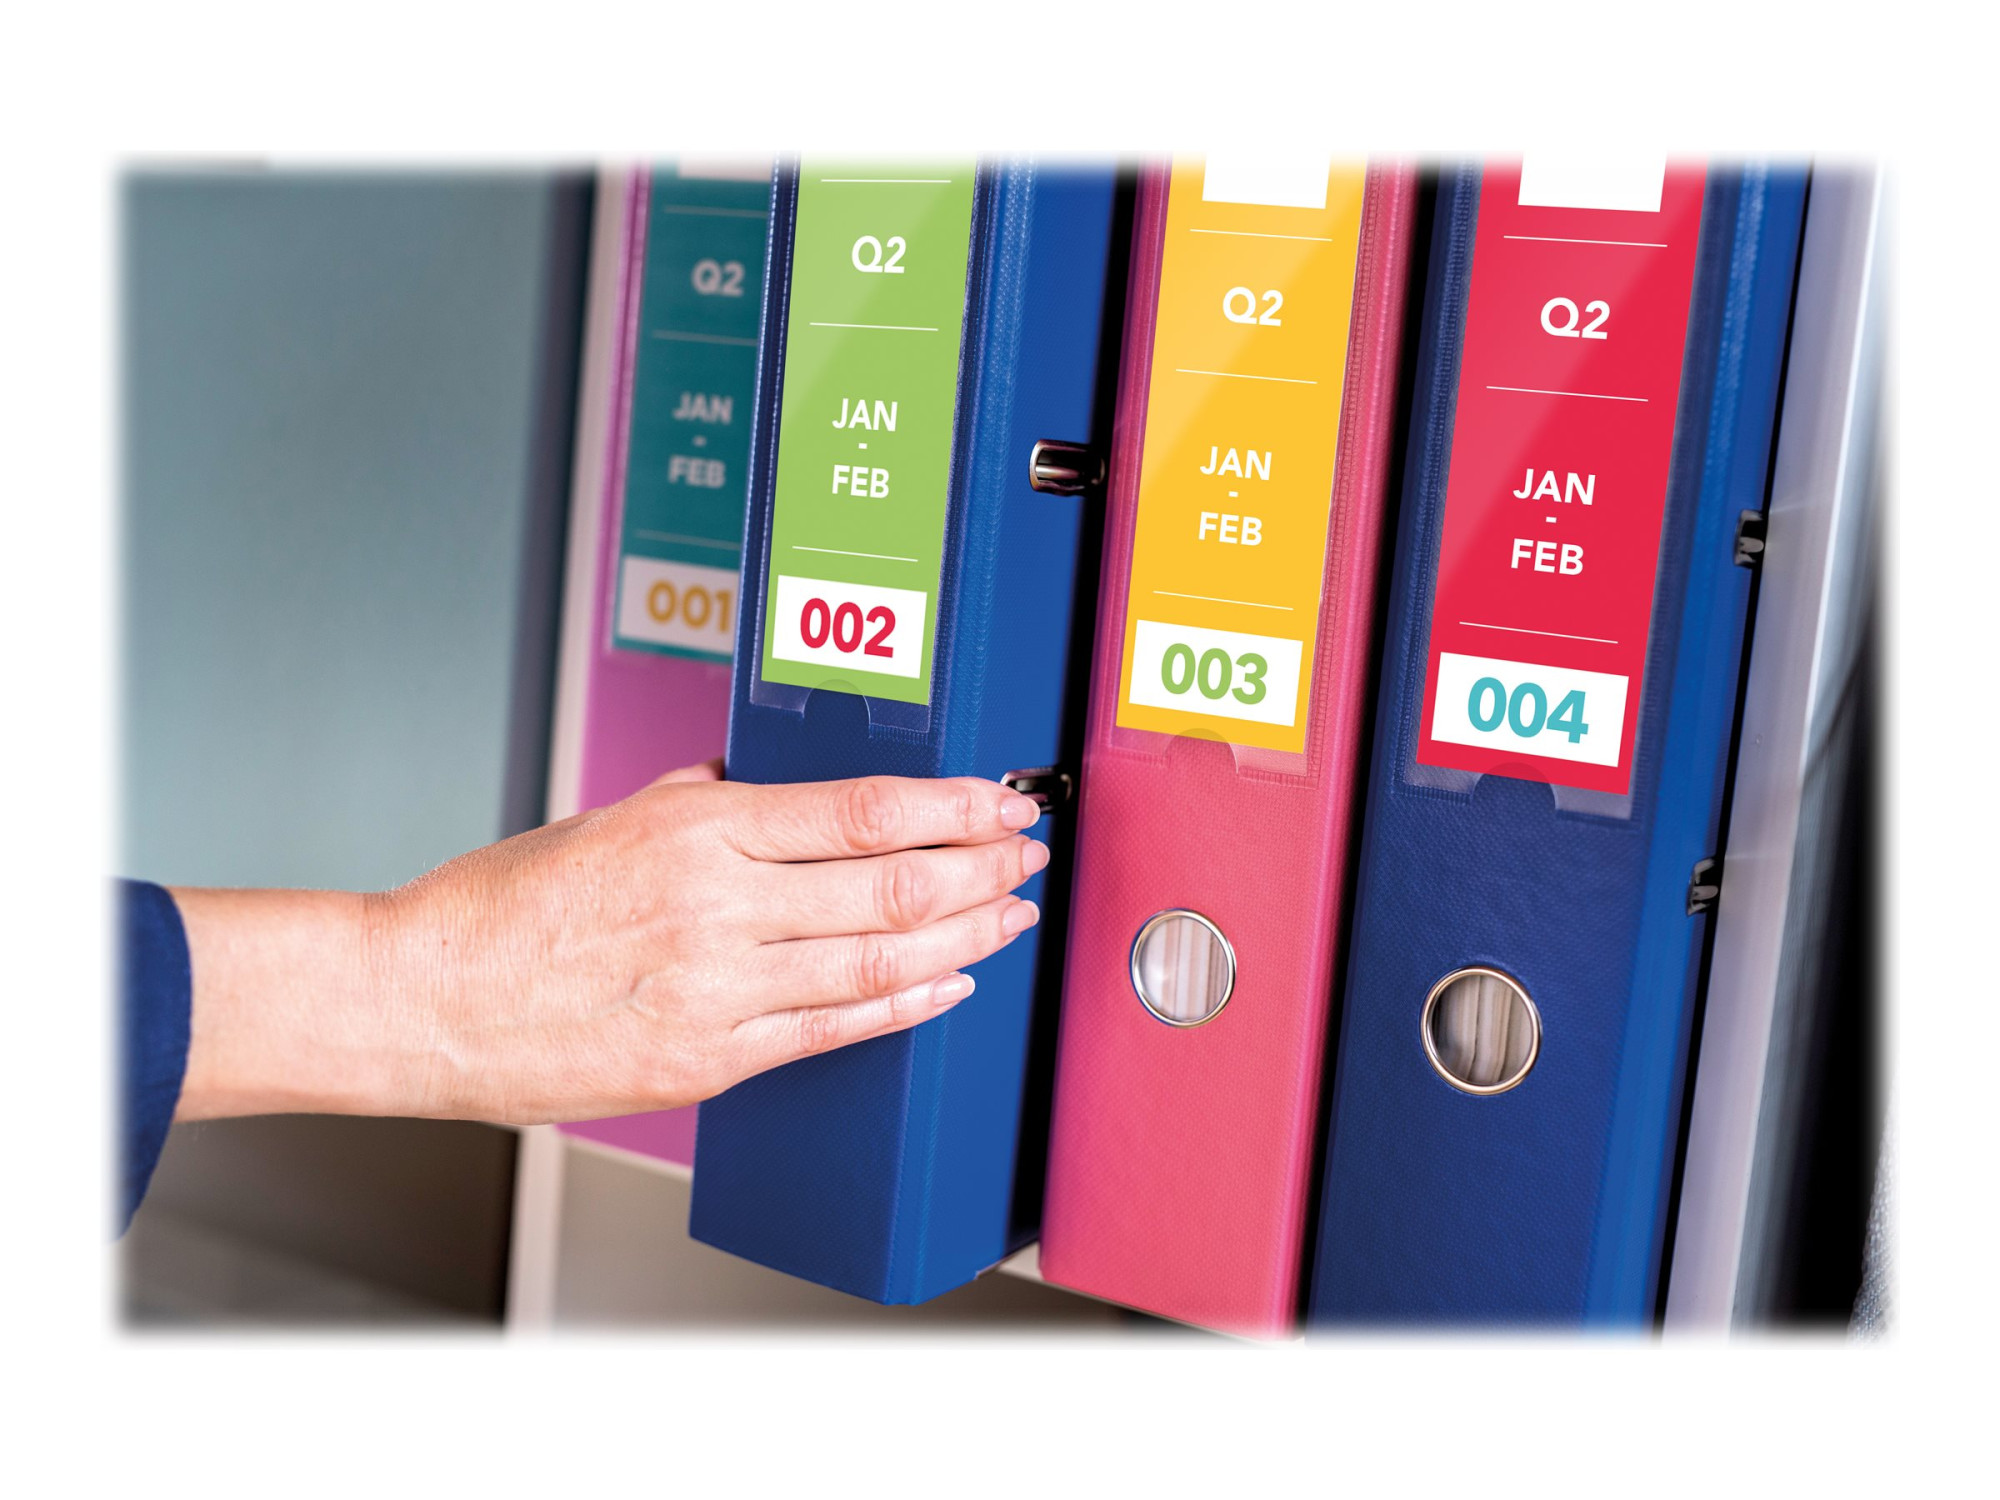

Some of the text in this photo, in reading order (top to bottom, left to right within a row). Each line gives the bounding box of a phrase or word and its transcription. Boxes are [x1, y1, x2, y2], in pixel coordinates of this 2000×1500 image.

[852, 236, 906, 273] Q2
[692, 260, 744, 296] Q2
[1223, 287, 1283, 326] Q2
[1541, 297, 1610, 339] Q2
[674, 394, 732, 423] JAN
[832, 398, 897, 431] JAN
[669, 456, 725, 488] FEB
[1200, 446, 1272, 480] JAN
[832, 465, 889, 498] FEB
[1513, 469, 1595, 505] JAN
[1199, 512, 1262, 545] FEB
[1511, 539, 1583, 575] FEB
[647, 580, 730, 633] 001
[800, 598, 895, 658] 002
[1161, 643, 1268, 705] 003
[1467, 676, 1589, 744] 004
